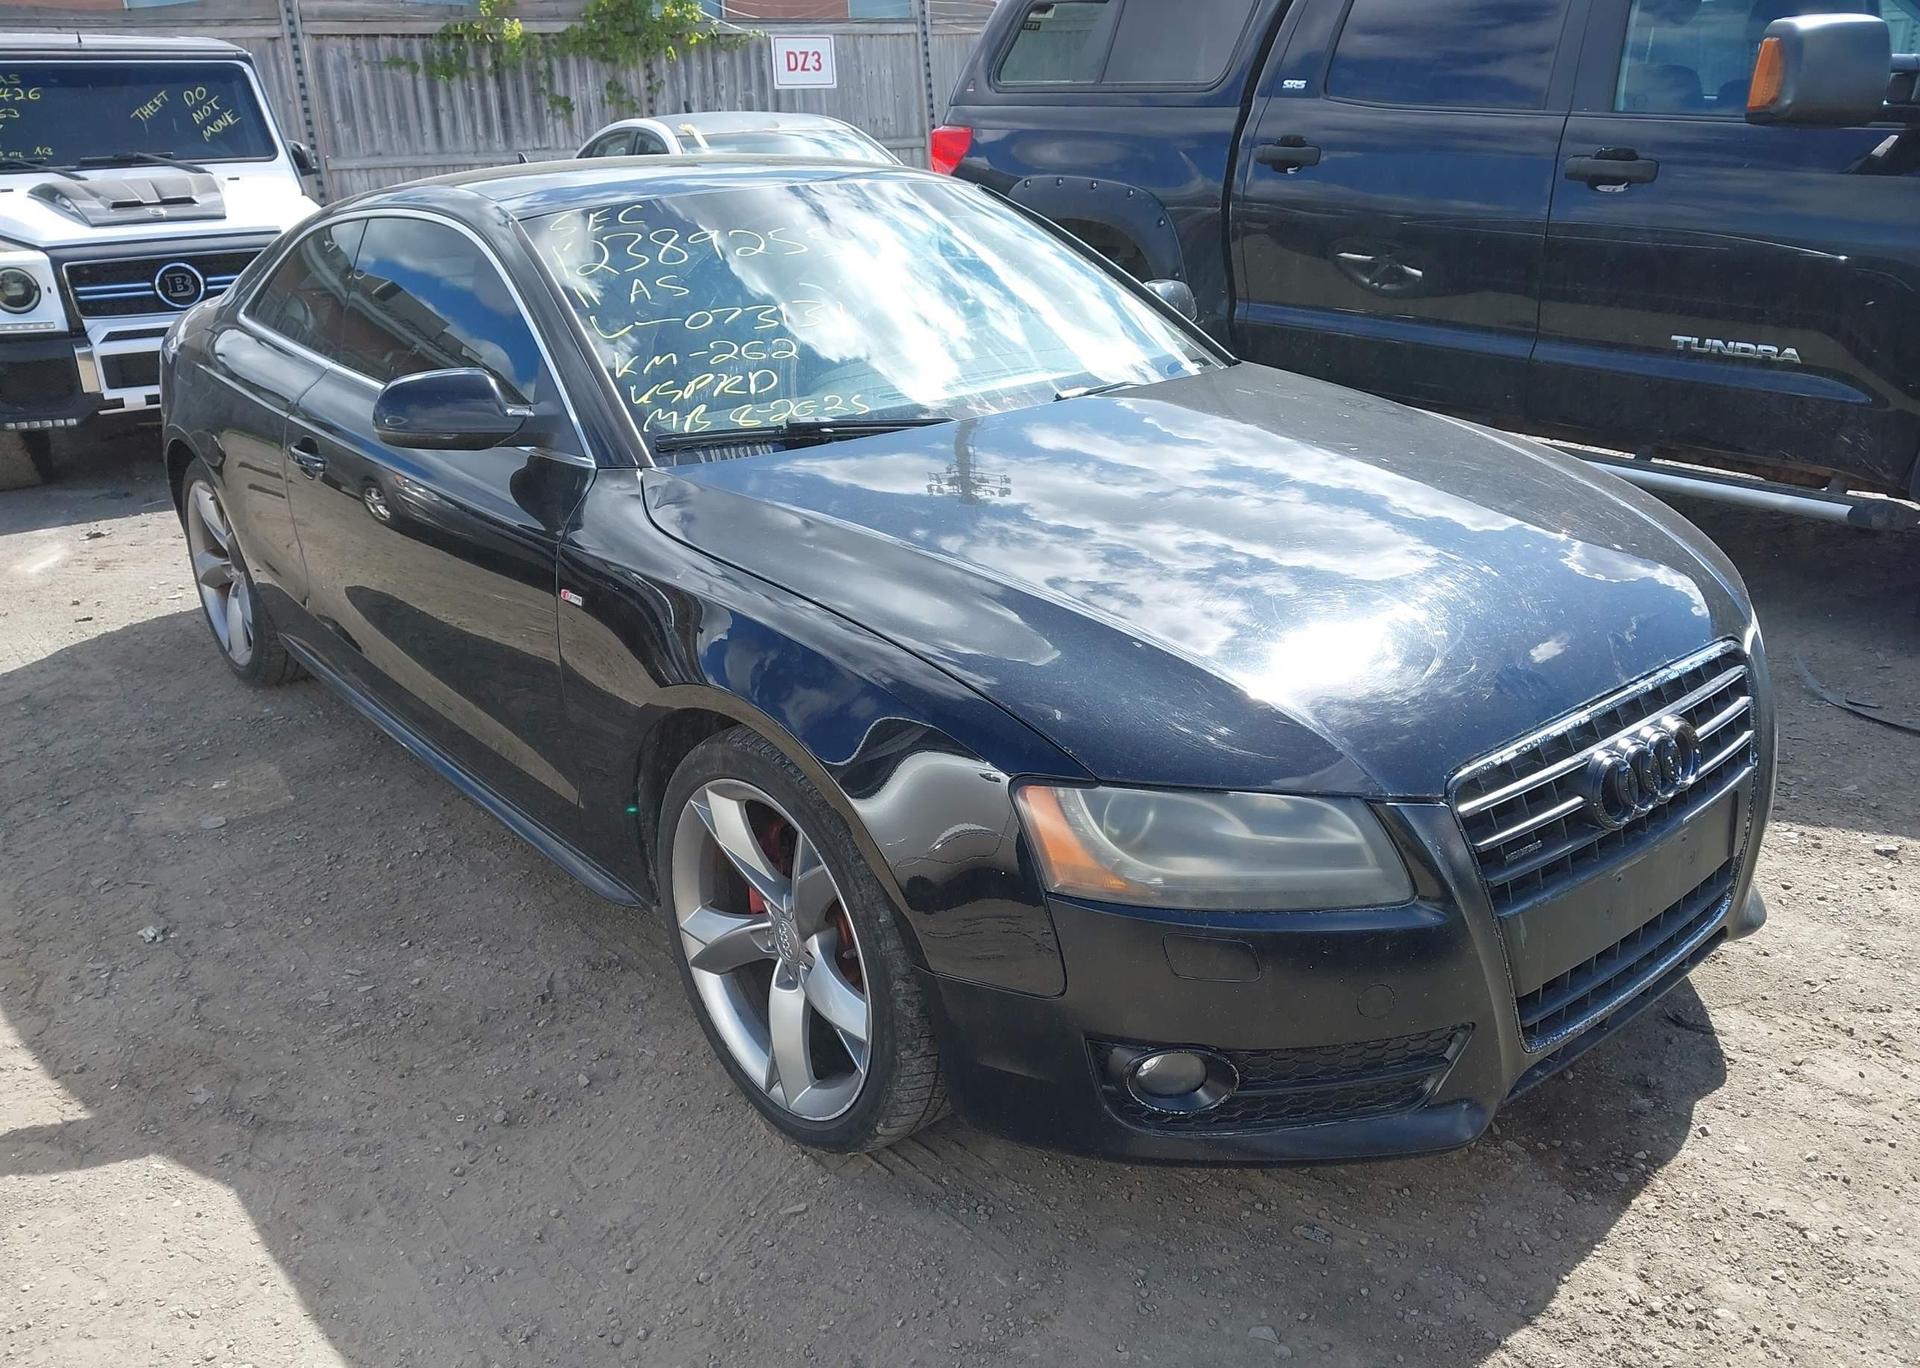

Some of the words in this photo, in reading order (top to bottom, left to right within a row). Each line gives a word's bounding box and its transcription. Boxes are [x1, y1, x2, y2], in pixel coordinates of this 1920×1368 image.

[786, 51, 822, 72] DZ3
[130, 90, 169, 121] THEFT
[183, 86, 207, 107] DO
[192, 95, 220, 124] NOT
[202, 109, 241, 142] MOVE
[1671, 335, 1802, 364] TUNDRA
